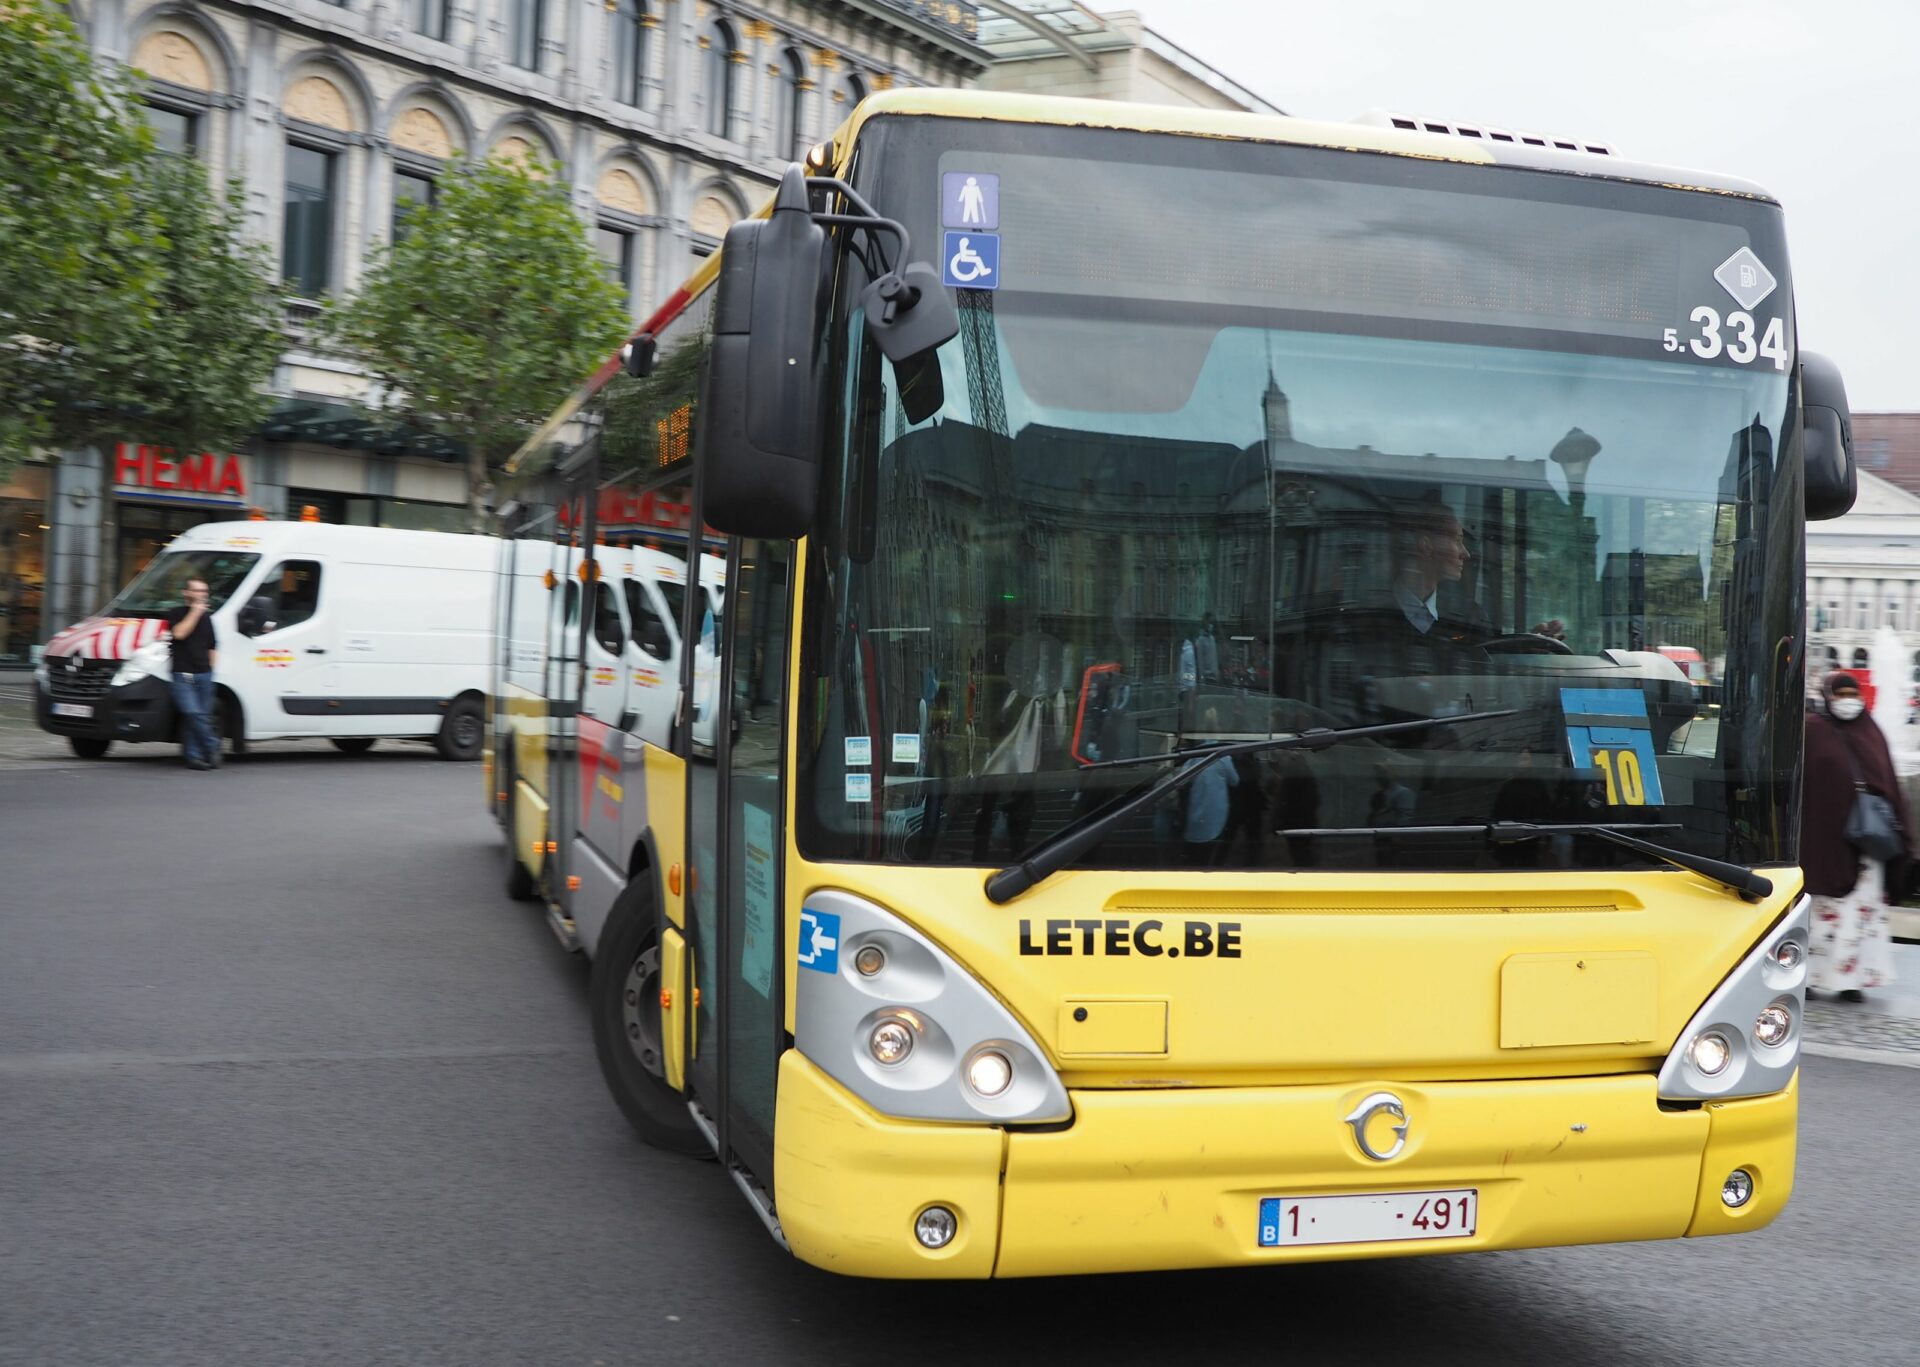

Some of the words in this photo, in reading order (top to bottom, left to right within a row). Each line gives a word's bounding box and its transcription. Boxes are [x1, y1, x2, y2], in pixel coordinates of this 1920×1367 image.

[114, 442, 246, 495] HEMA
[1594, 750, 1645, 806] 10
[1019, 919, 1241, 958] LETEC.BE
[1263, 1226, 1276, 1241] B
